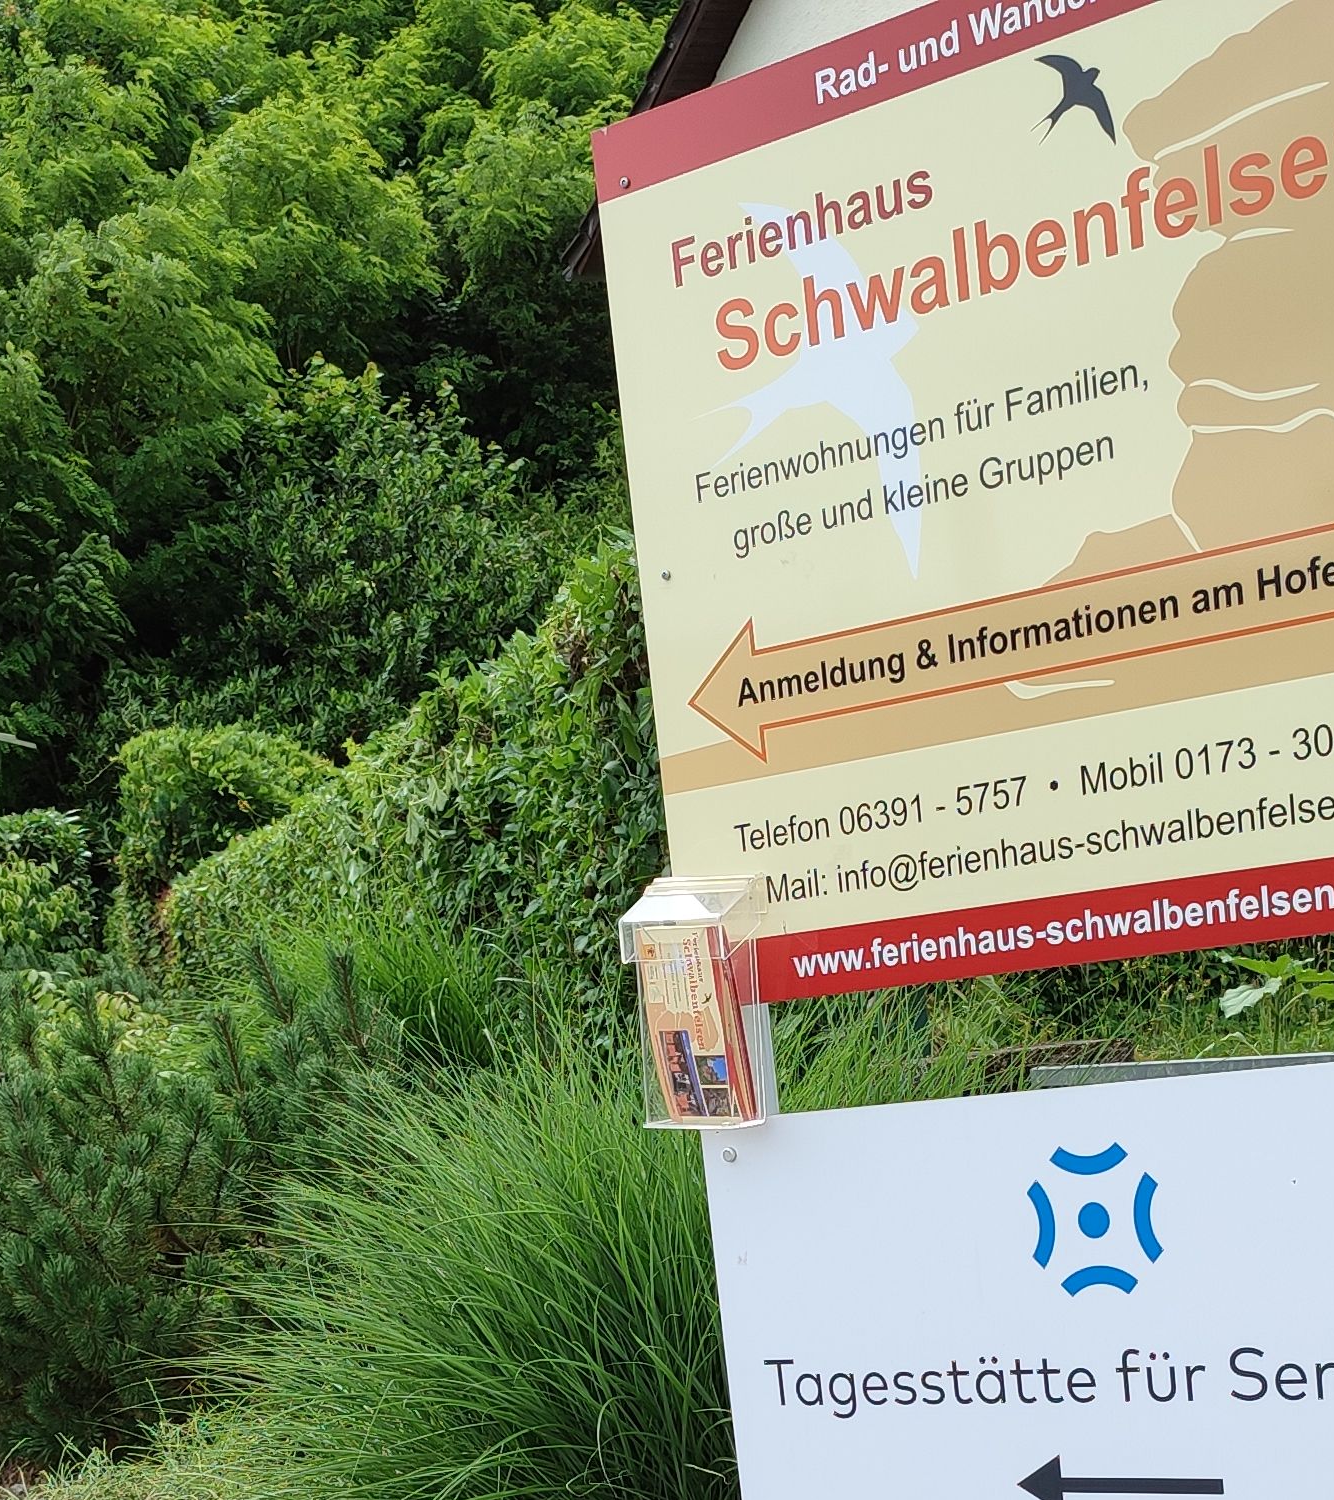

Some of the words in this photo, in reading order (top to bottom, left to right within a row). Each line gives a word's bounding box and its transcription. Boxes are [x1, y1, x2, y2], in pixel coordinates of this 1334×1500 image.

[815, 51, 889, 105] Rad-
[898, 20, 960, 73] und
[671, 169, 933, 288] Ferienhaus
[695, 413, 946, 504] Ferienwohnungen
[954, 399, 995, 435] für
[1005, 363, 1149, 423] Familien,
[733, 508, 813, 560] große
[822, 489, 874, 530] und
[883, 471, 969, 515] kleine
[980, 434, 1115, 490] Gruppen
[737, 646, 906, 709] Anmeldung
[915, 637, 939, 671] &
[947, 583, 1179, 666] Informationen
[1191, 577, 1244, 615] am
[734, 814, 830, 853] Telefon
[839, 794, 923, 836] 06391
[955, 775, 1028, 816] 5757
[1079, 751, 1164, 796] Mobil
[1175, 736, 1257, 780] 0173
[765, 867, 828, 904] Mail:
[764, 1355, 1097, 1419] Tagesstätte
[1114, 1348, 1206, 1403] für
